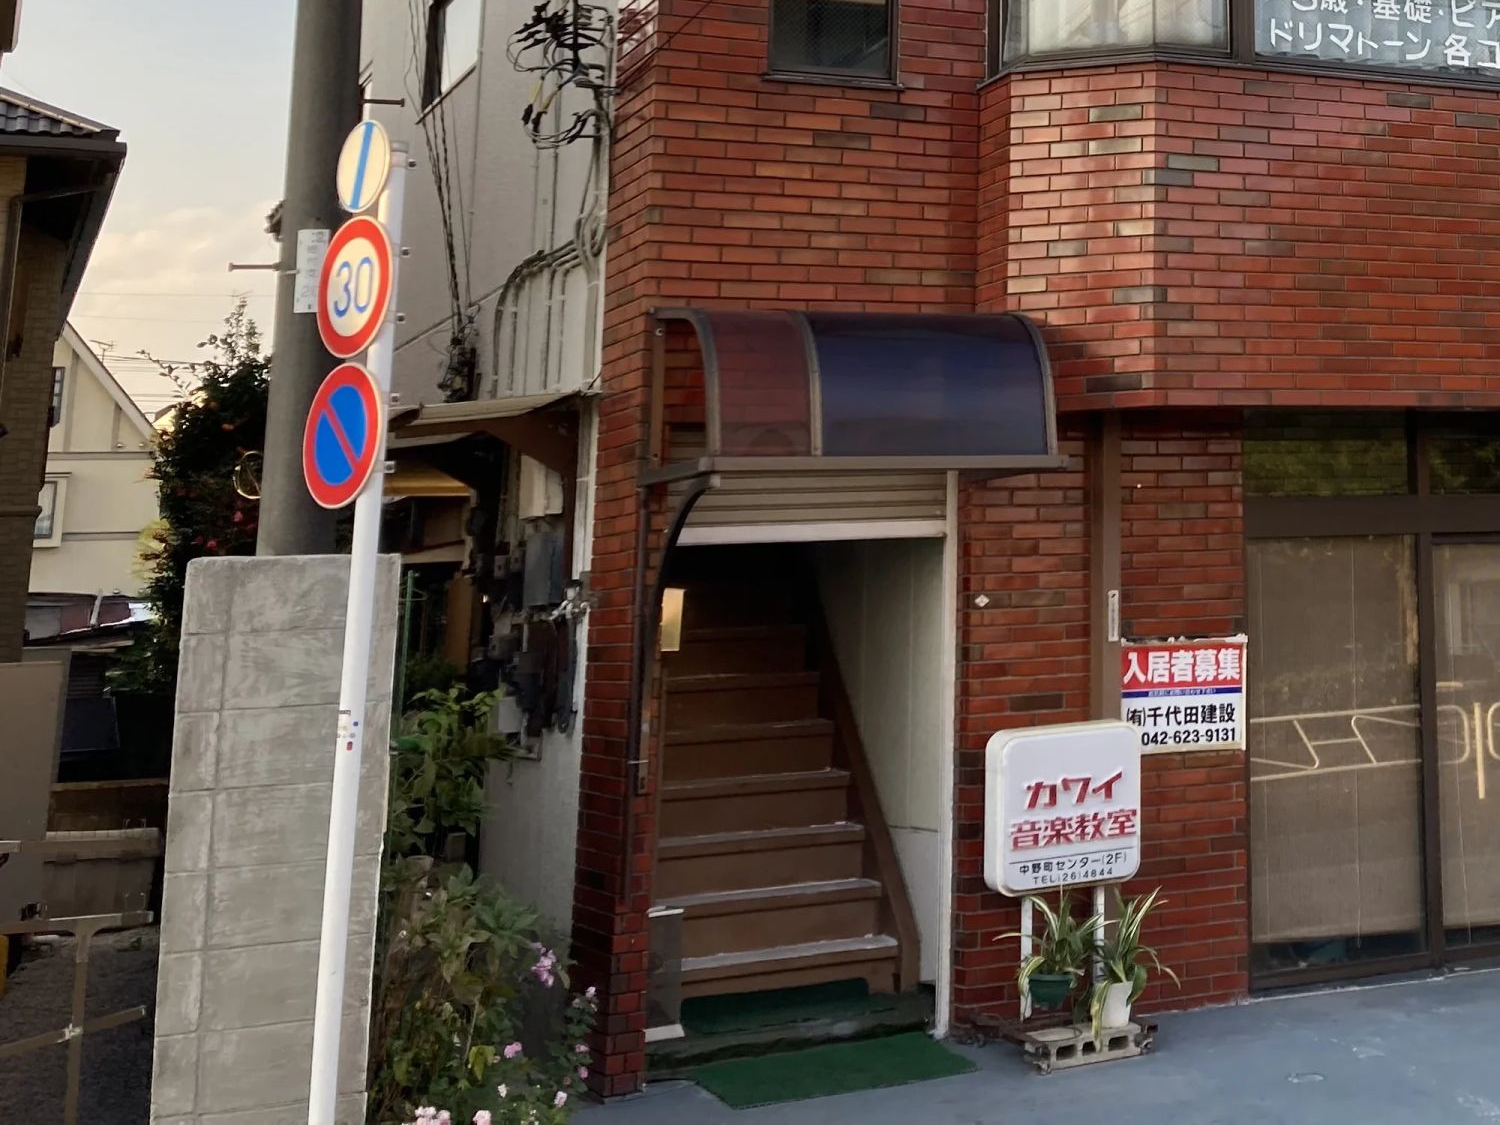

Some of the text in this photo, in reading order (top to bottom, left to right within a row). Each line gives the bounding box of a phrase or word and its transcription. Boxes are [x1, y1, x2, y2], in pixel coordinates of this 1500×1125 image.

[1270, 18, 1432, 60] ドリマトーン
[334, 256, 373, 318] 30
[1123, 648, 1241, 684] 入居者募集
[1127, 703, 1236, 726] (有)千代田建設
[1141, 728, 1236, 745] 042-623-9131
[1026, 770, 1123, 810] カワイ
[1011, 808, 1138, 851] 音楽教室
[1019, 852, 1127, 874] 中野町センター(2F)
